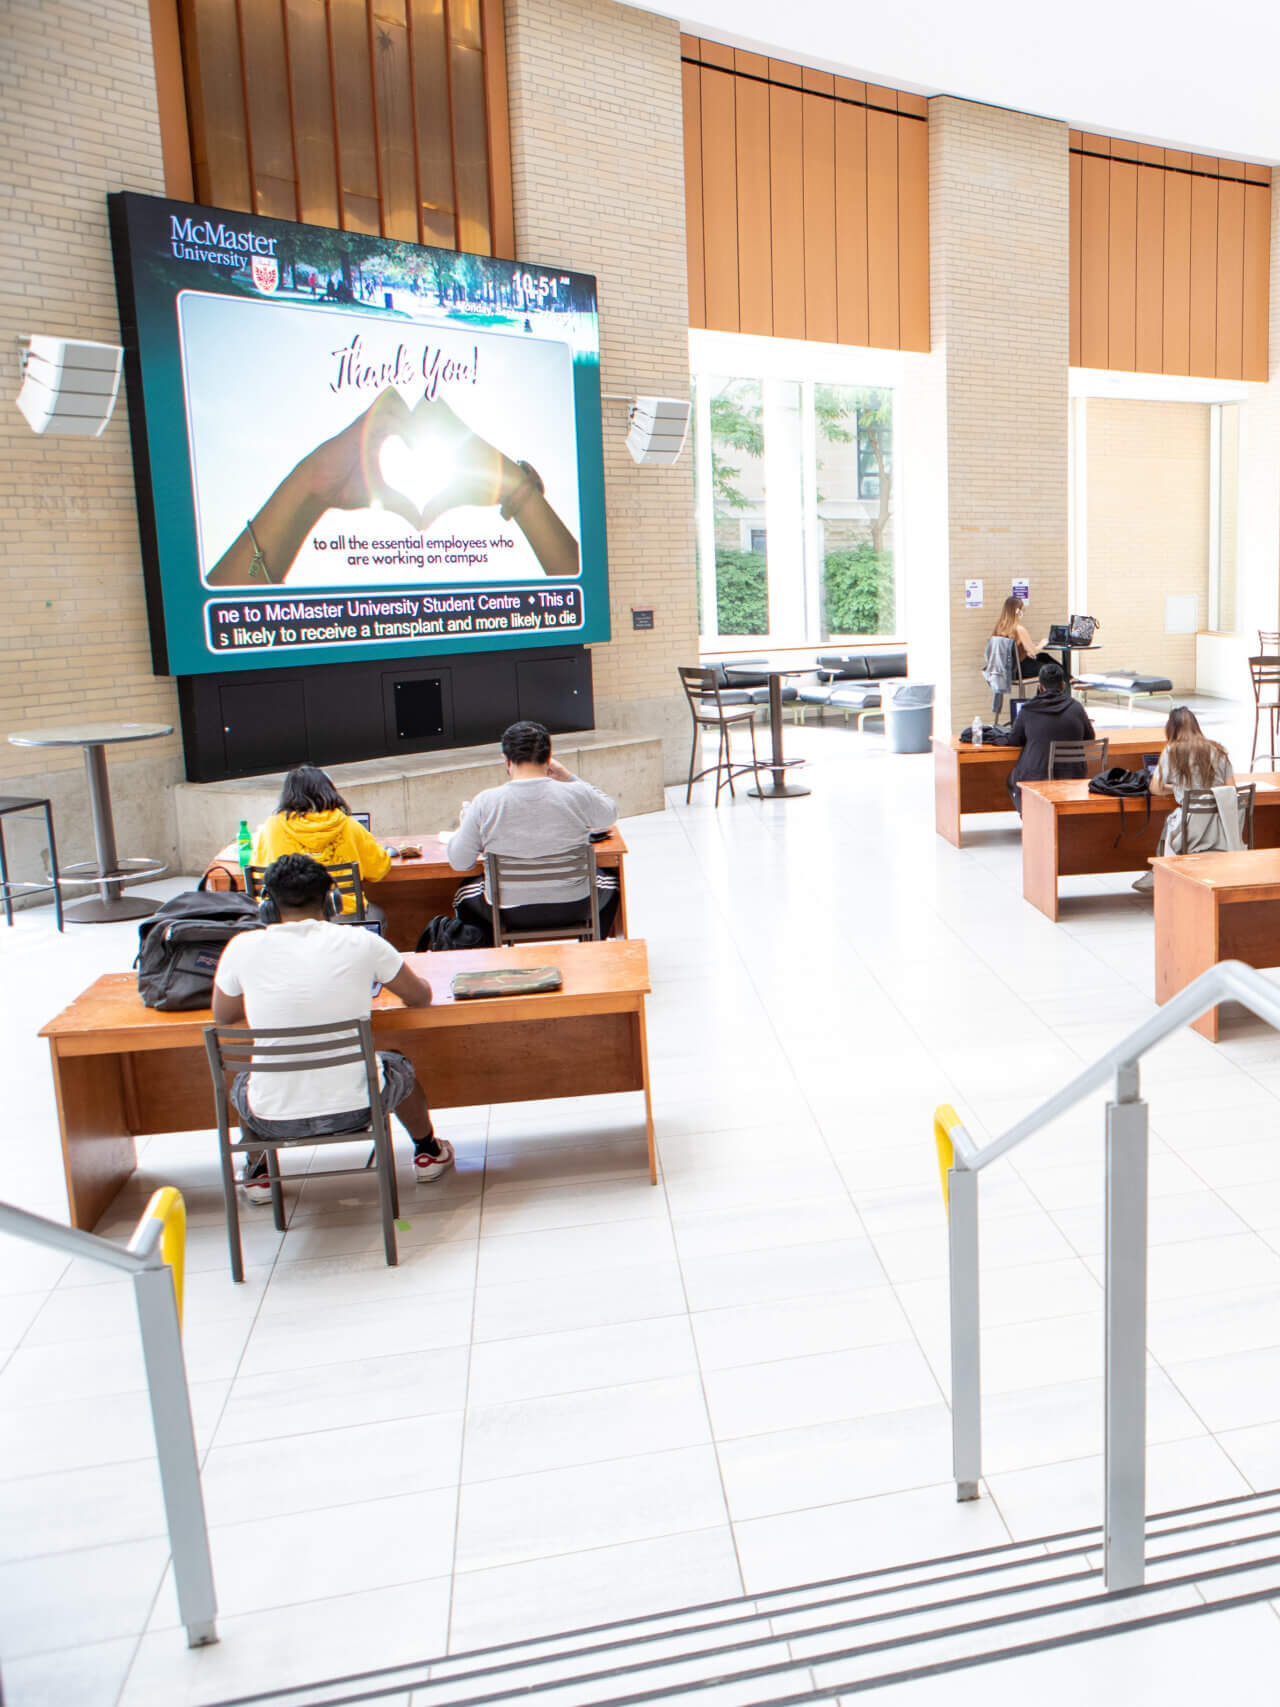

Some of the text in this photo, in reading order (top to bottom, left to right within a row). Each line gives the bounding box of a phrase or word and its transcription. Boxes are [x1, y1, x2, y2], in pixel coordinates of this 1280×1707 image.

[169, 214, 278, 256] McMaster
[171, 241, 248, 273] University
[513, 272, 557, 298] 10:51
[329, 334, 479, 401] Thank You!
[313, 535, 514, 553] to all the essential employees who
[347, 550, 488, 568] are working on campus
[243, 606, 262, 623] to
[264, 602, 344, 621] McMaster
[347, 597, 419, 617] University
[422, 594, 476, 614] Student
[477, 594, 521, 611] Centre
[538, 592, 565, 607] This
[220, 609, 577, 647] s likely to receive a transplant and more likely to die
